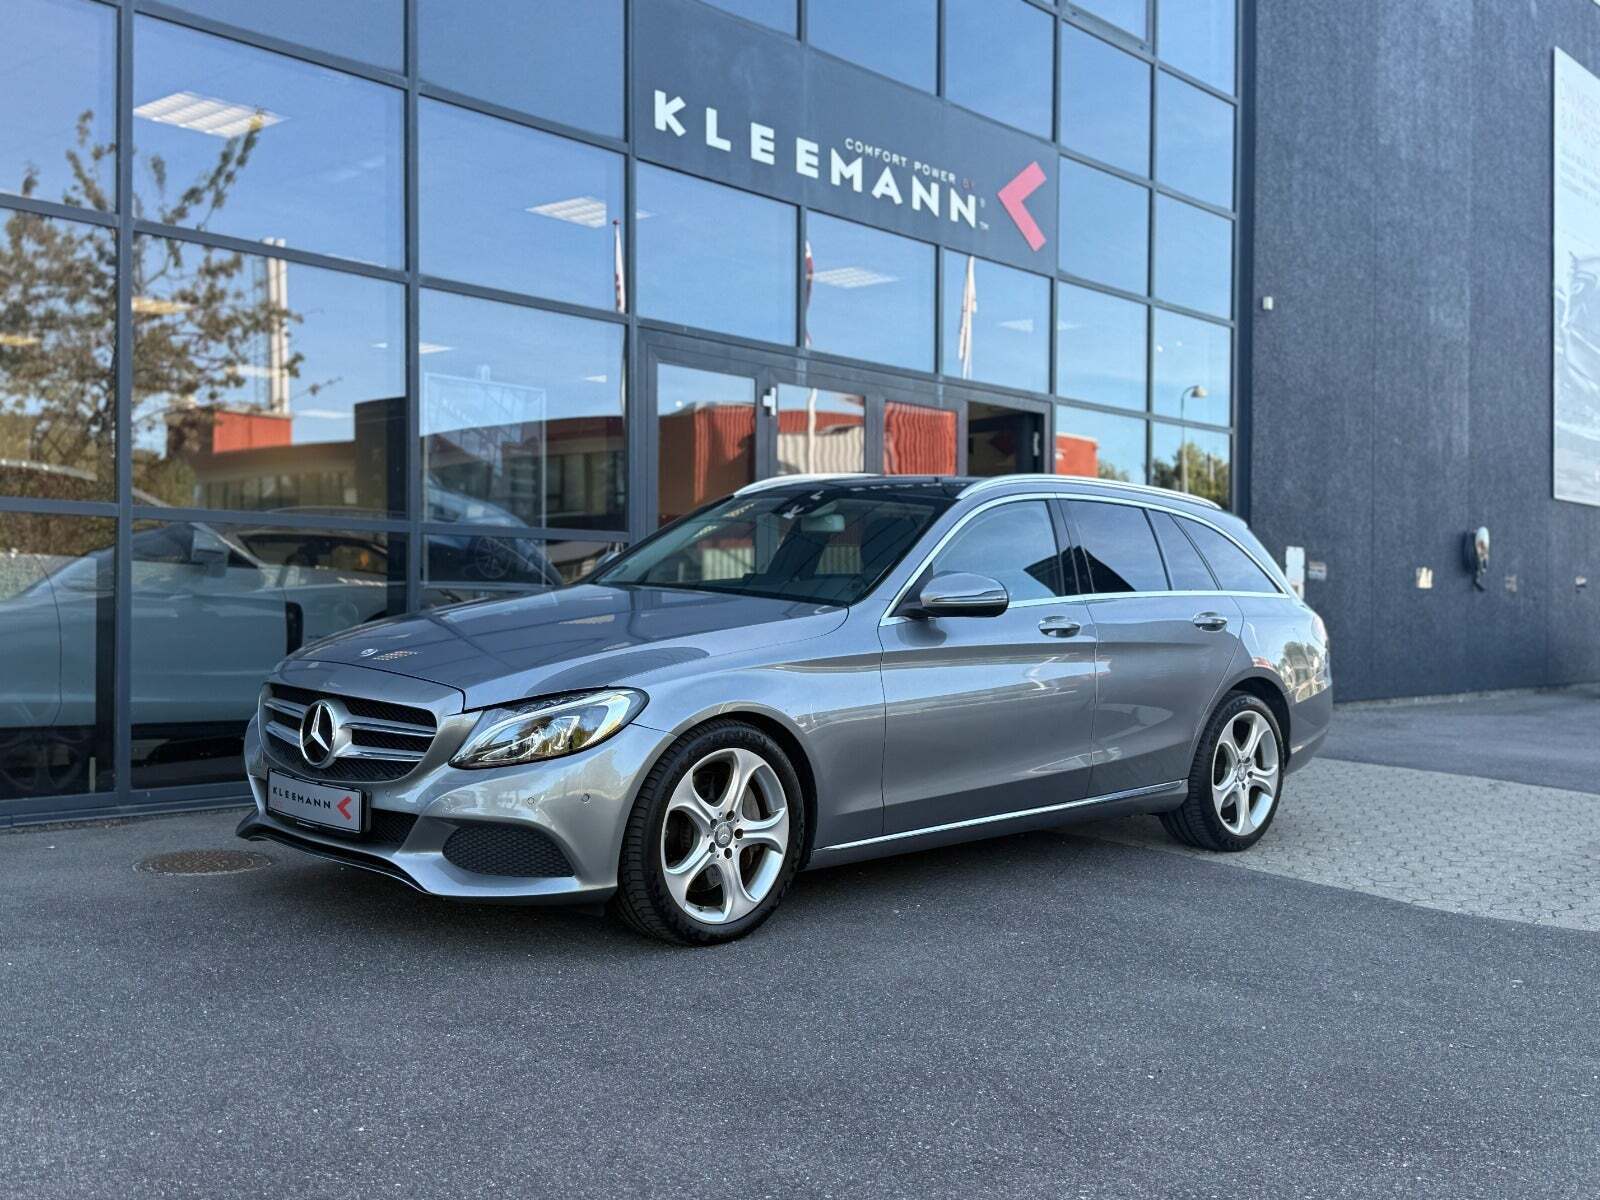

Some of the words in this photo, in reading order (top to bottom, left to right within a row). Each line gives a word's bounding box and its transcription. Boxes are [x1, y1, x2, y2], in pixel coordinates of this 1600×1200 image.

[654, 90, 977, 229] KLEEMANN
[844, 138, 908, 168] COMFORT
[913, 161, 956, 184] POWER
[272, 786, 331, 809] KLEEMANN
